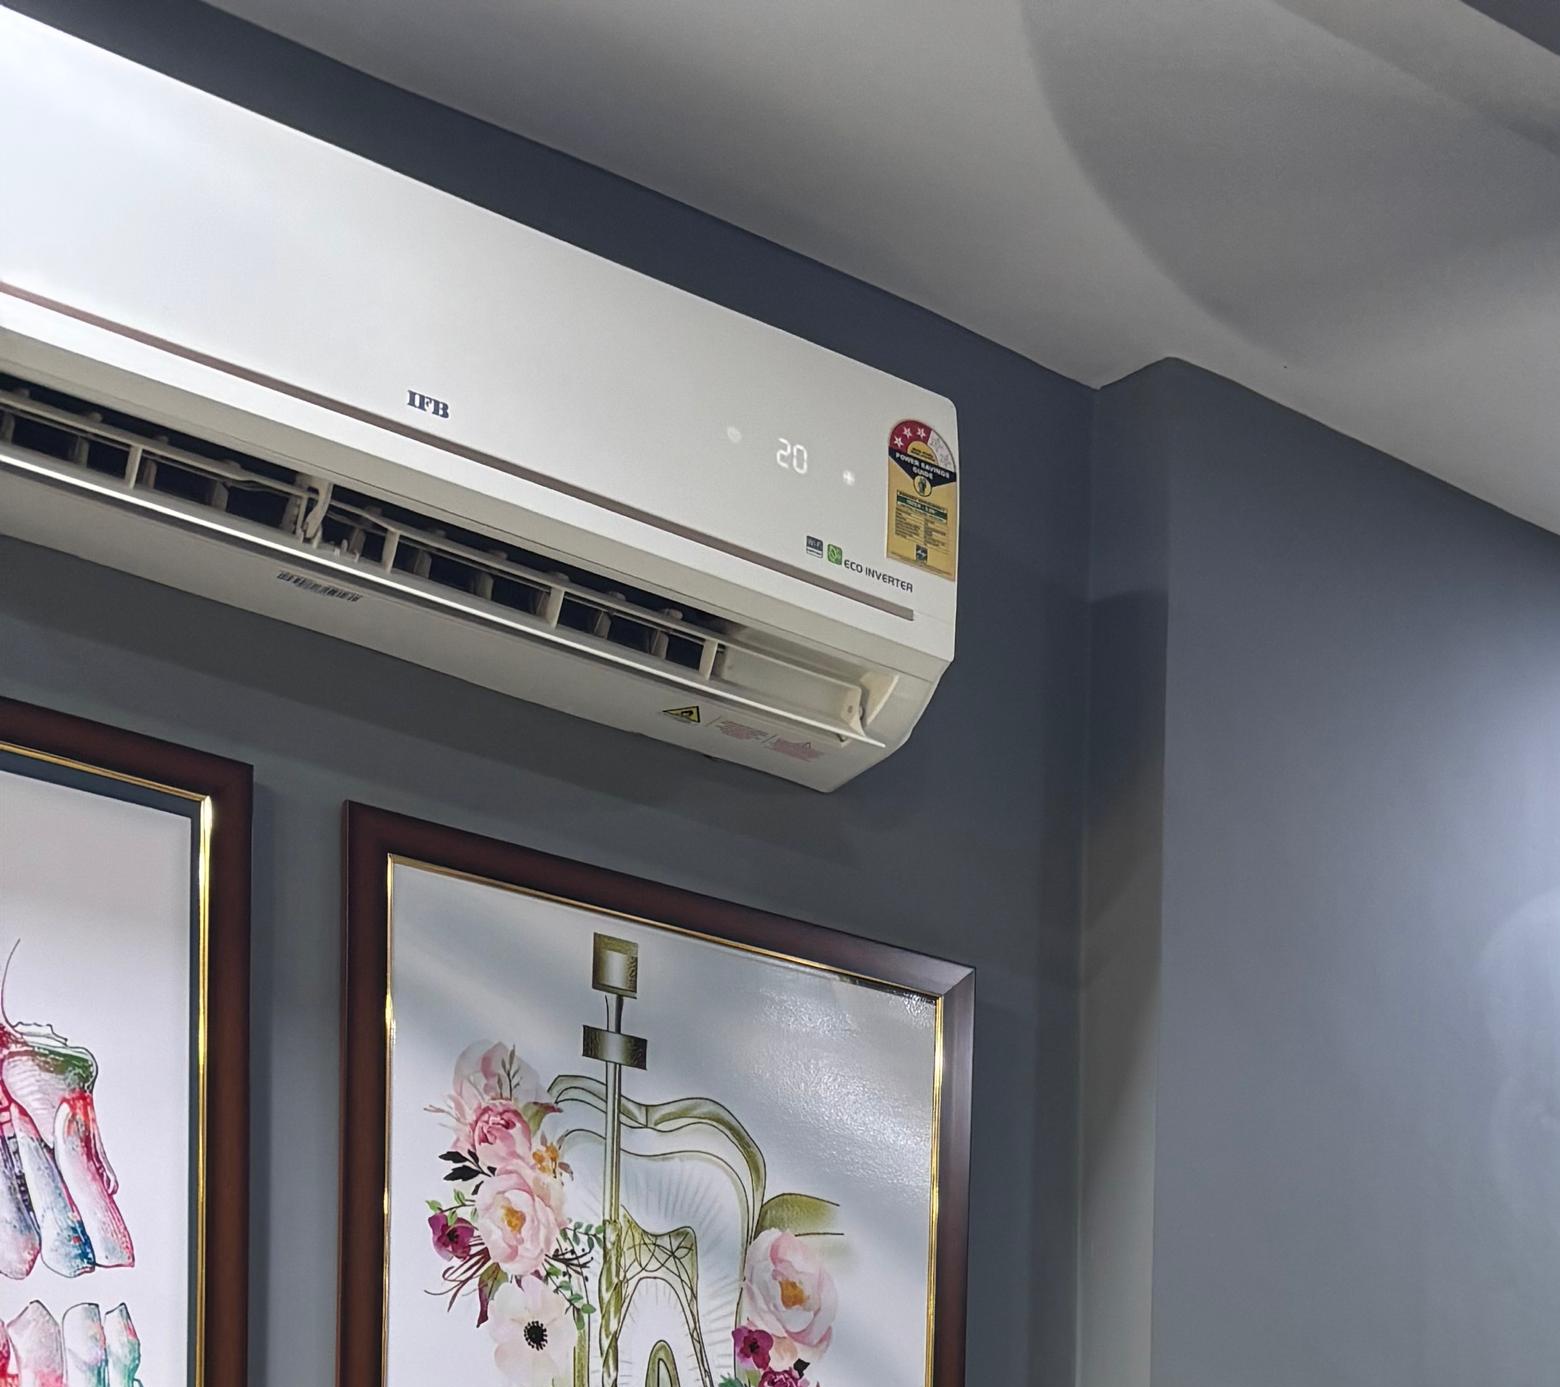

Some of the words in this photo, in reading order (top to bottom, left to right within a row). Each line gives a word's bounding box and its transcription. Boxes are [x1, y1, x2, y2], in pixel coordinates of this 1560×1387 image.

[408, 390, 449, 418] IFB
[776, 438, 807, 474] 20
[895, 452, 920, 467] POWER
[844, 559, 863, 573] ECO
[865, 567, 913, 592] INVERTER
